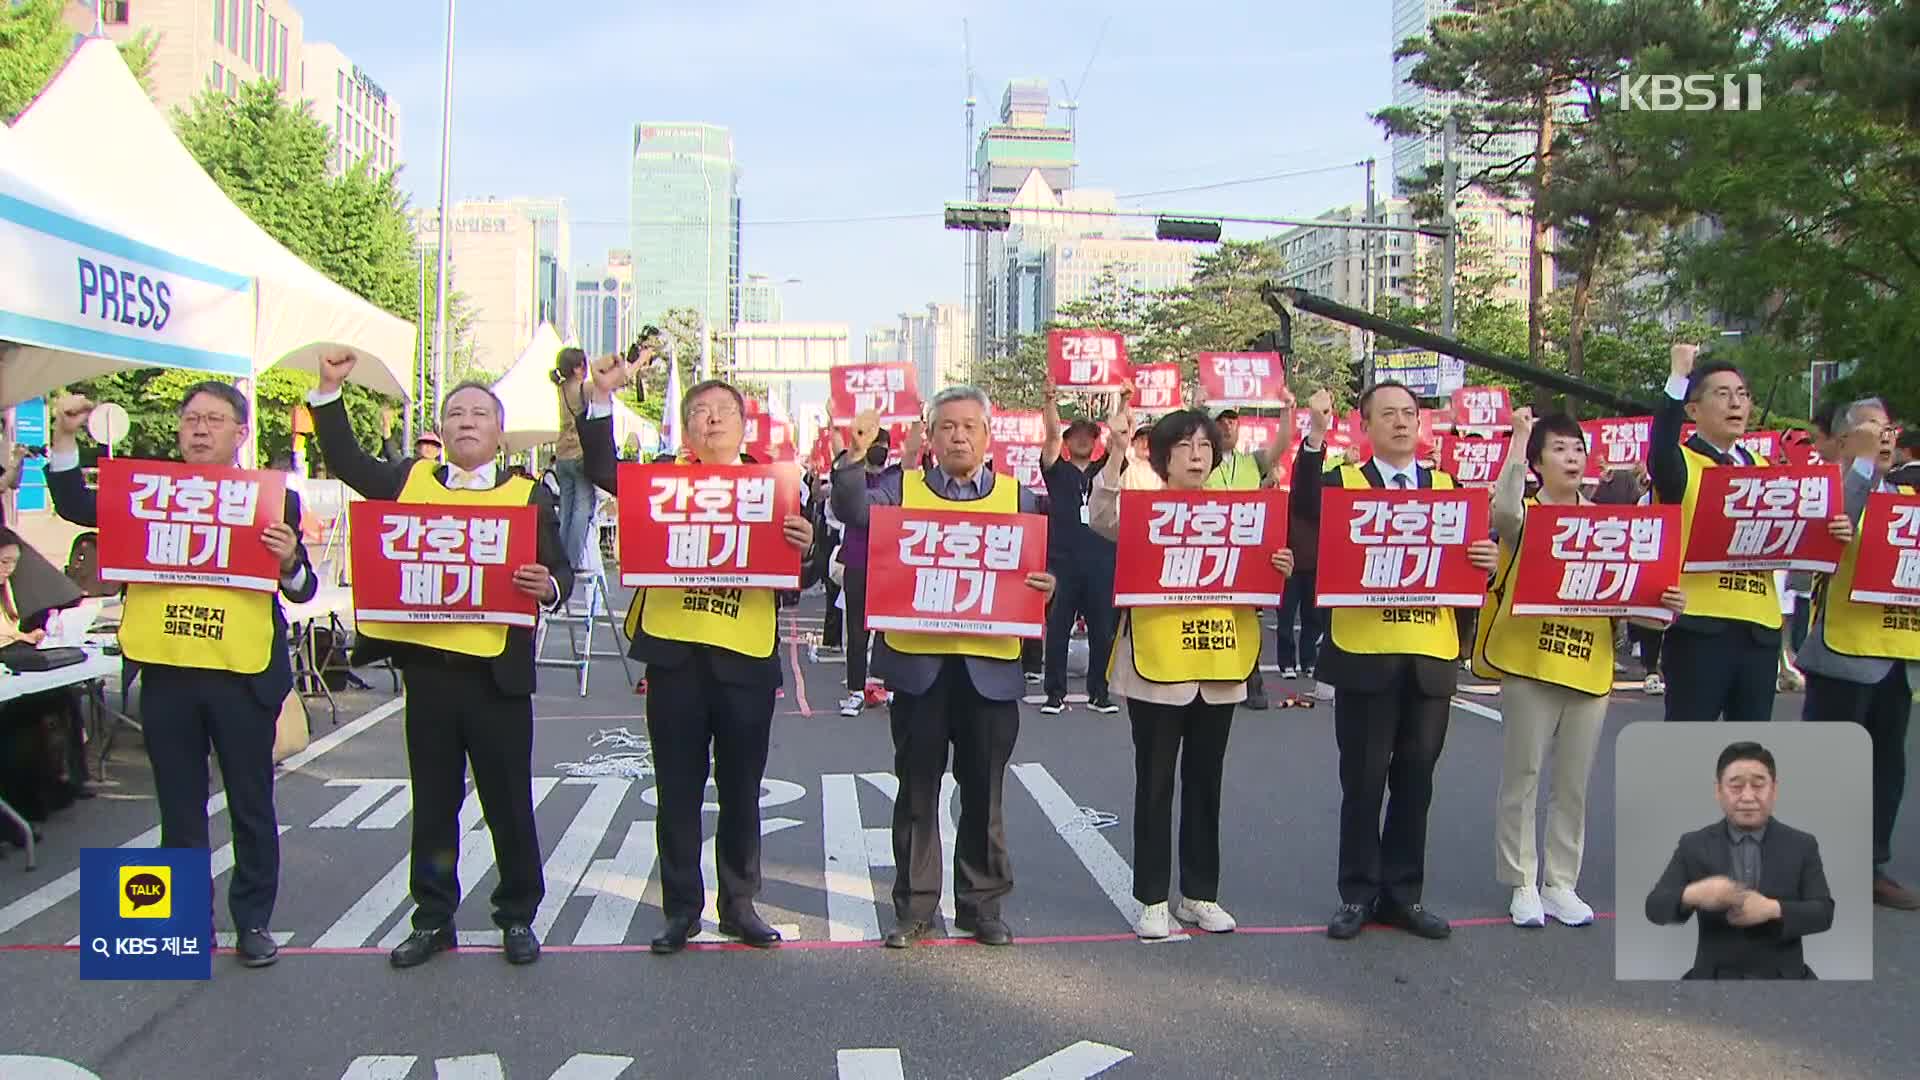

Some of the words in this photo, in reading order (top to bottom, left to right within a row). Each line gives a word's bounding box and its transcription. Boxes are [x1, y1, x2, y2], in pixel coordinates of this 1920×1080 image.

[78, 257, 170, 330] PRESS
[1061, 337, 1117, 360] 간호법
[1212, 358, 1270, 376] 간호법
[845, 369, 904, 392] 간호법
[1453, 442, 1502, 463] 간호법
[1601, 422, 1648, 443] 간호법
[129, 473, 260, 527] 간호법
[649, 476, 776, 523] 간호법
[1722, 476, 1828, 518] 간호법
[381, 515, 511, 565] 간호법
[1149, 501, 1267, 545] 간호법
[1349, 500, 1469, 545] 간호법
[1551, 516, 1663, 561] 간호법
[1726, 519, 1807, 556] 폐기
[145, 521, 231, 569] 폐기
[666, 524, 751, 568] 폐기
[899, 521, 1024, 570] 간호법
[400, 563, 484, 607] 폐기
[1158, 547, 1241, 588] 폐기
[1360, 546, 1443, 588] 폐기
[1556, 561, 1641, 602] 폐기
[682, 596, 740, 620] 의료연대
[912, 567, 997, 615] 폐기
[163, 621, 225, 640] 의료연대
[164, 603, 225, 624] 보건복지
[1540, 621, 1595, 646] 보건복지
[1538, 636, 1592, 663] 의료연대
